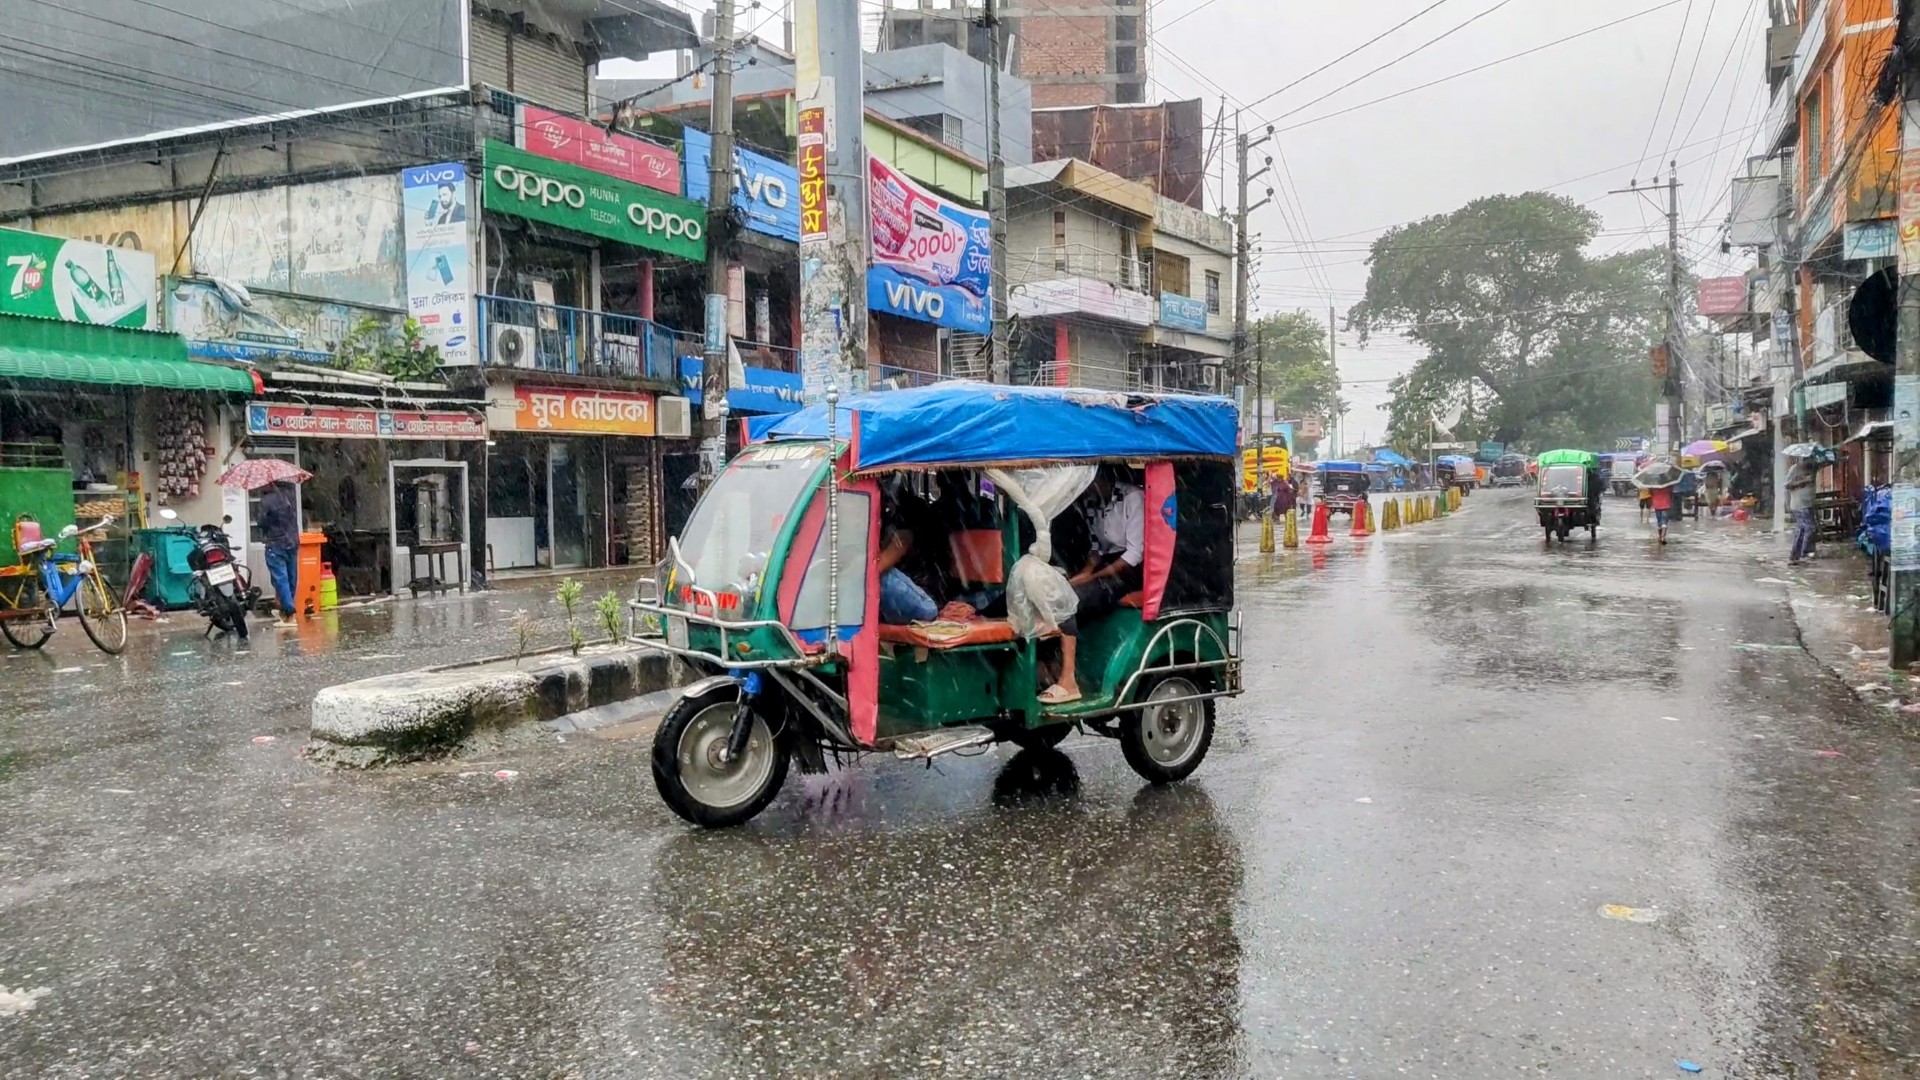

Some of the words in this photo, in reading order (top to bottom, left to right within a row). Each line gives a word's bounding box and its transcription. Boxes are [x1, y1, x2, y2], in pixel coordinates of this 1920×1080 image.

[413, 170, 455, 184] vivo
[494, 165, 585, 209] oppo
[589, 186, 621, 203] MUNNA
[627, 203, 701, 241] oppo
[884, 279, 944, 318] vivo
[530, 393, 566, 428] মুন
